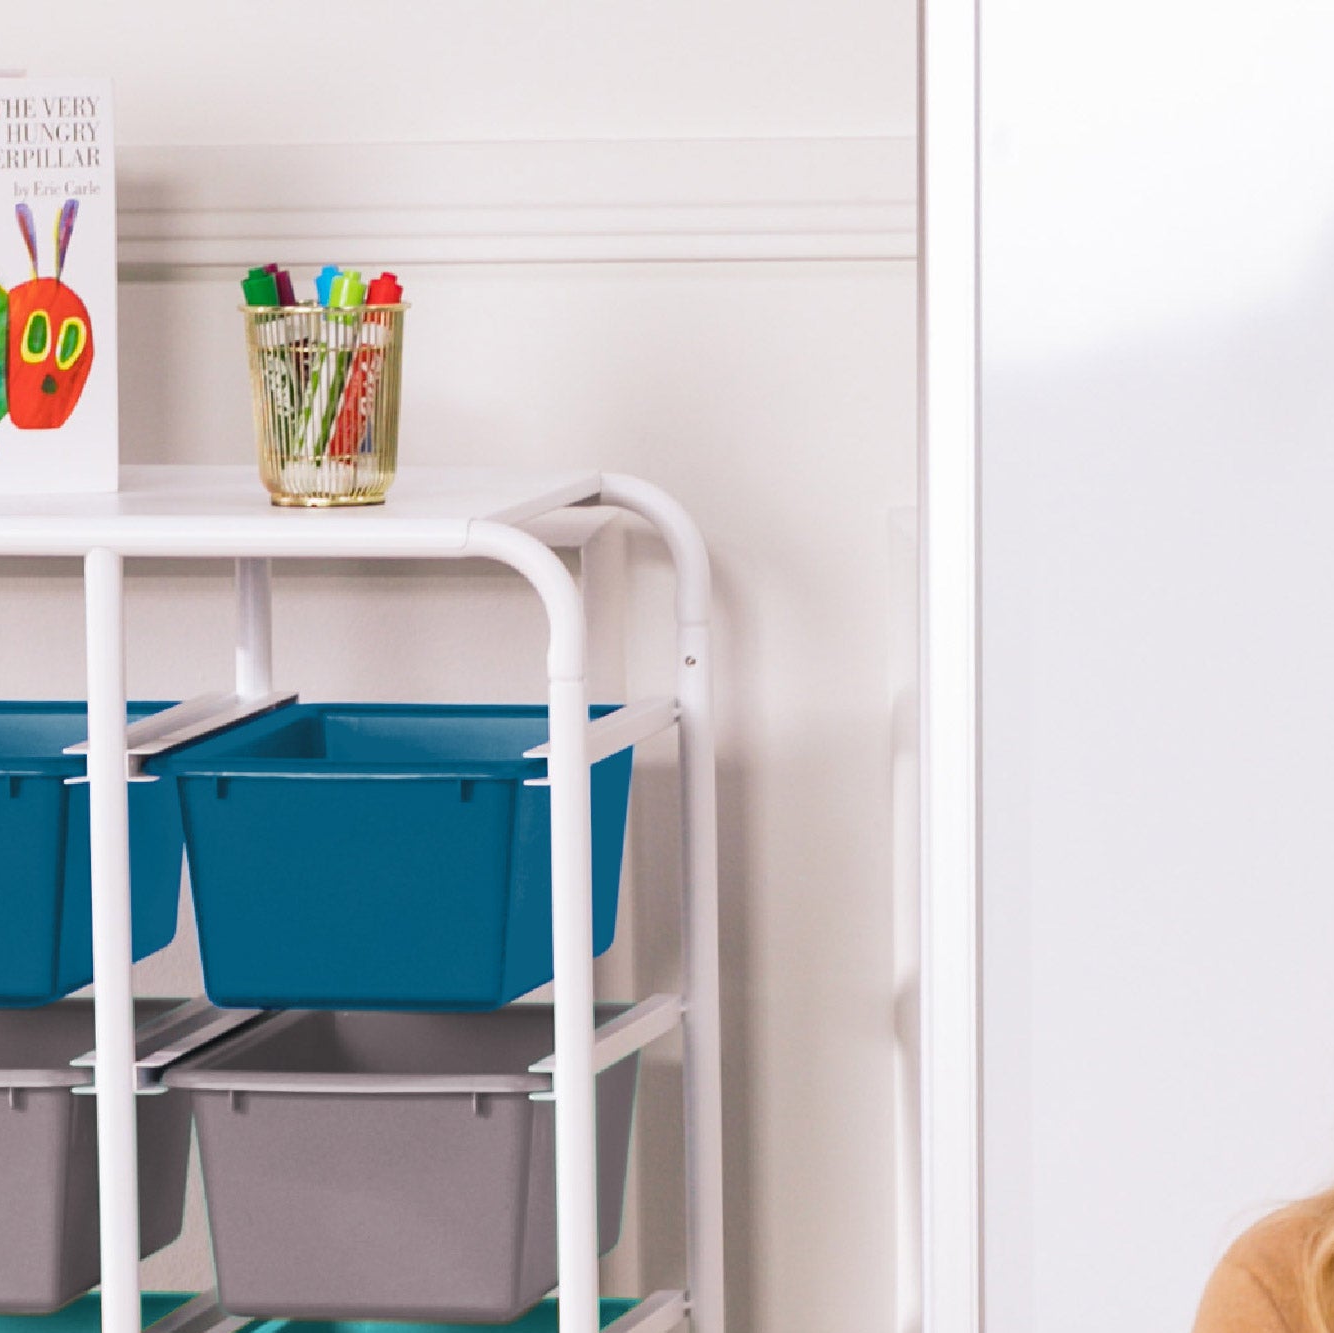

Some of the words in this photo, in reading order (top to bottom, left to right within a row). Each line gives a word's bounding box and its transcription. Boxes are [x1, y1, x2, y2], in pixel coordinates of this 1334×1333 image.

[42, 96, 100, 118] VERY
[7, 122, 100, 144] HUNGRY
[14, 181, 30, 197] by
[34, 181, 60, 196] Eric
[64, 181, 101, 195] Carle
